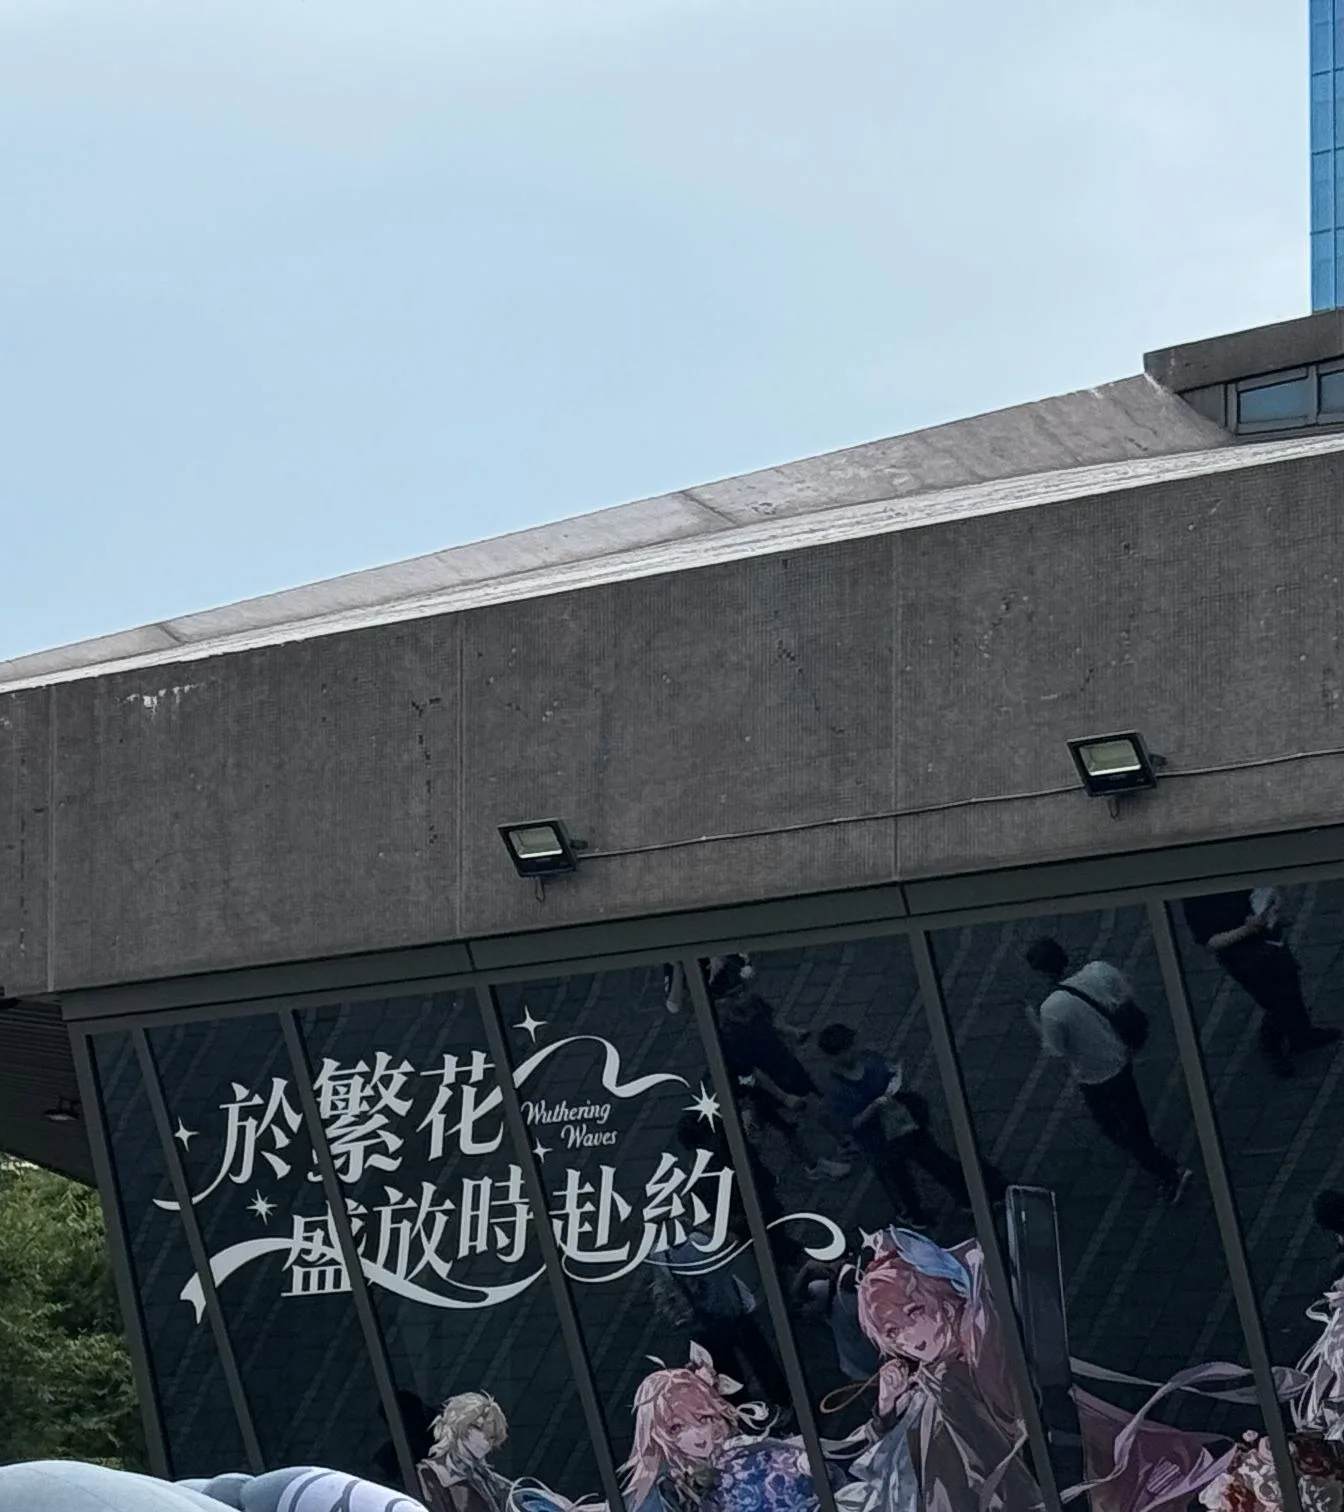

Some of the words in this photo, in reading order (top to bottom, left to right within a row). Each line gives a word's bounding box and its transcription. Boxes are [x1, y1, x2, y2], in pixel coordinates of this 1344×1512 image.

[194, 1050, 505, 1196] 於繁花
[520, 1100, 611, 1125] Wuthering
[560, 1123, 618, 1149] Waves
[280, 1148, 735, 1297] 盛放時赴約
